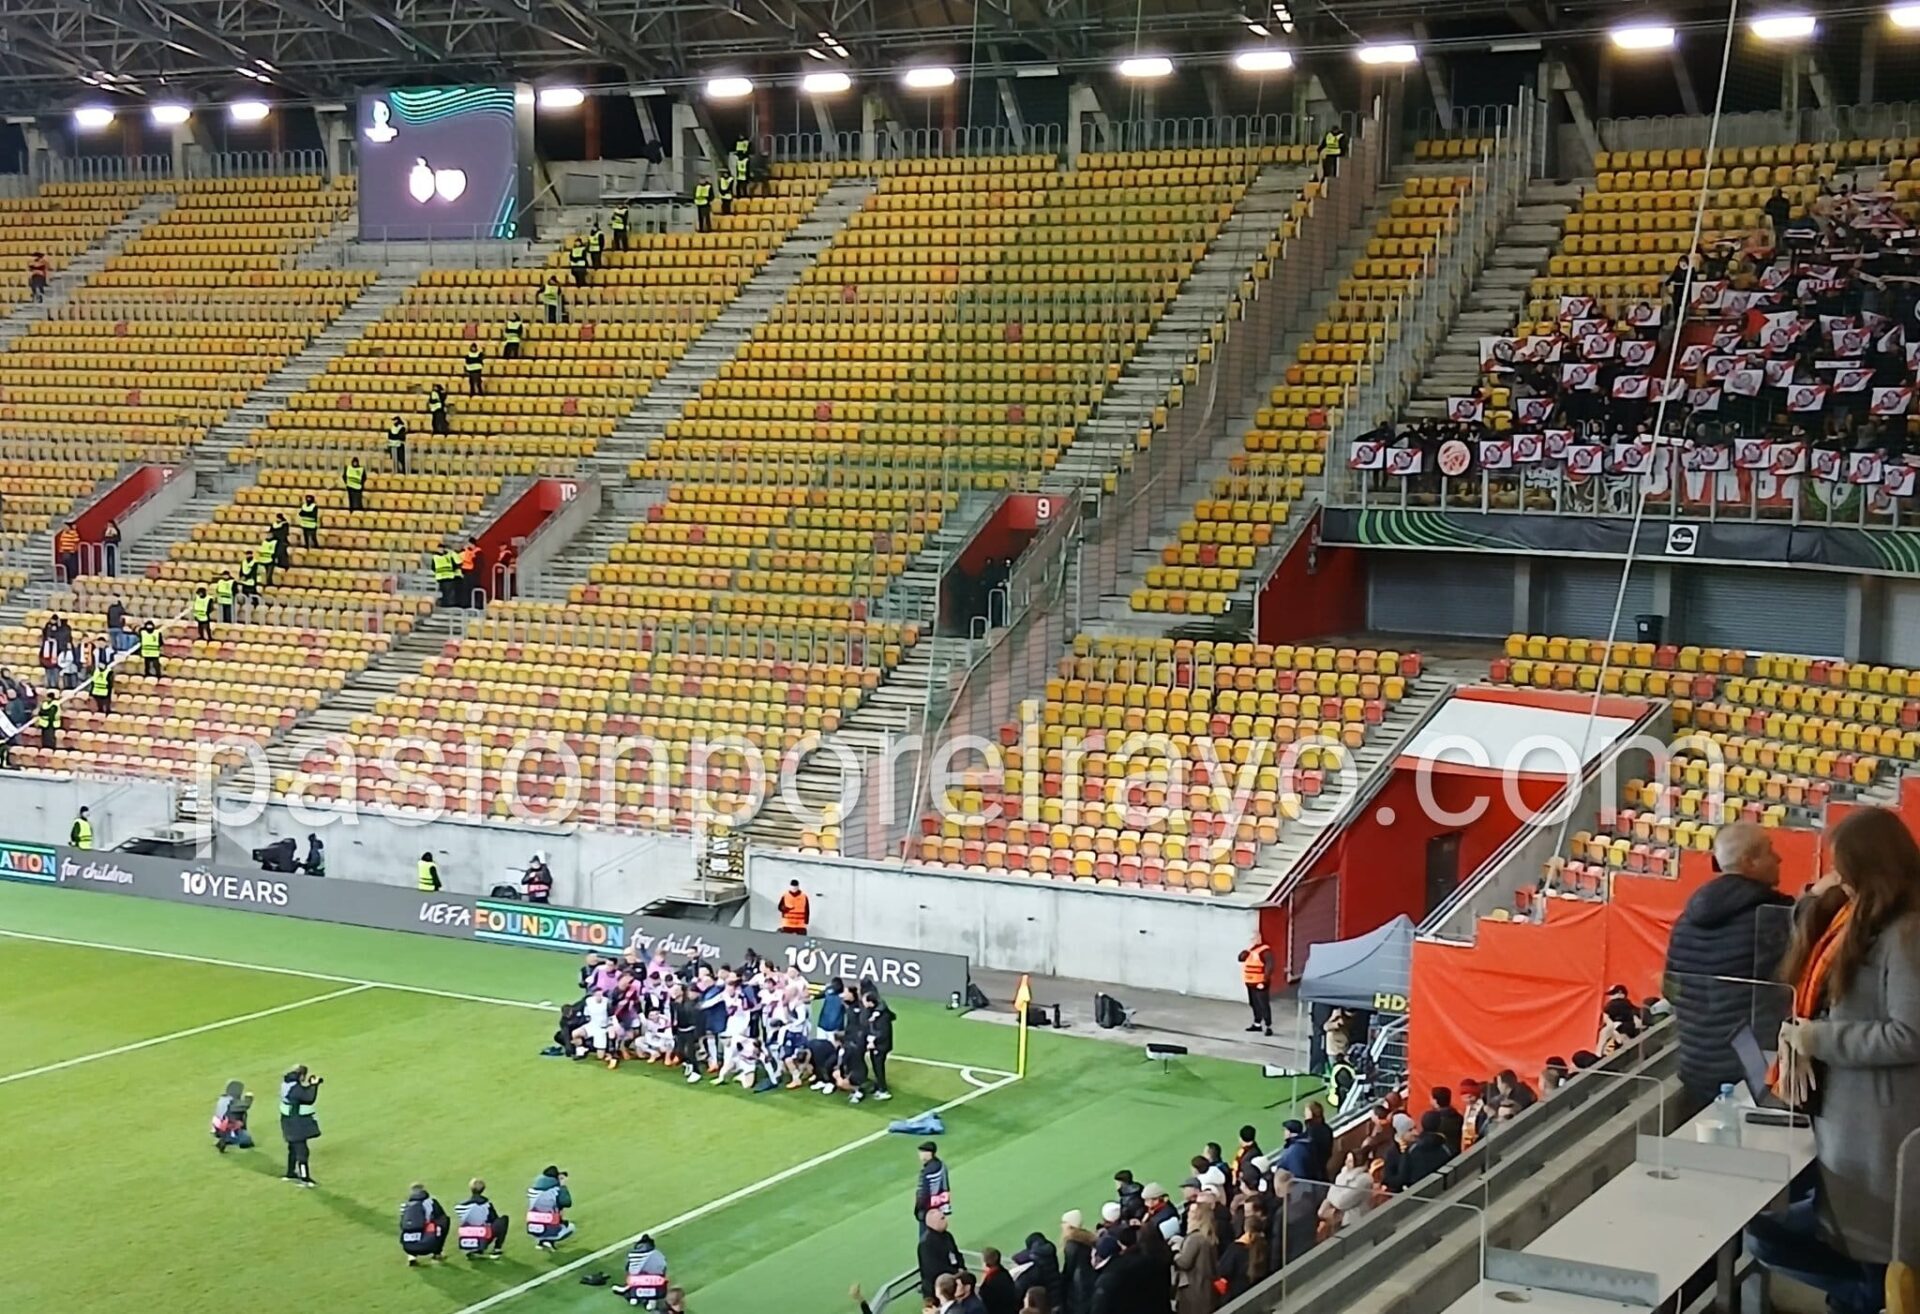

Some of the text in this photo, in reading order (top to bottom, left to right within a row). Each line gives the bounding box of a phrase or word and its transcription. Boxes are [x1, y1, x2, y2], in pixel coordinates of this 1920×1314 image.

[1036, 498, 1051, 519] 9
[60, 857, 81, 881] for
[83, 861, 133, 884] children
[208, 876, 289, 906] YEARS
[419, 902, 472, 927] UEFA
[474, 908, 625, 948] FOUNDATION
[630, 927, 655, 950] for
[818, 952, 921, 988] YEARS
